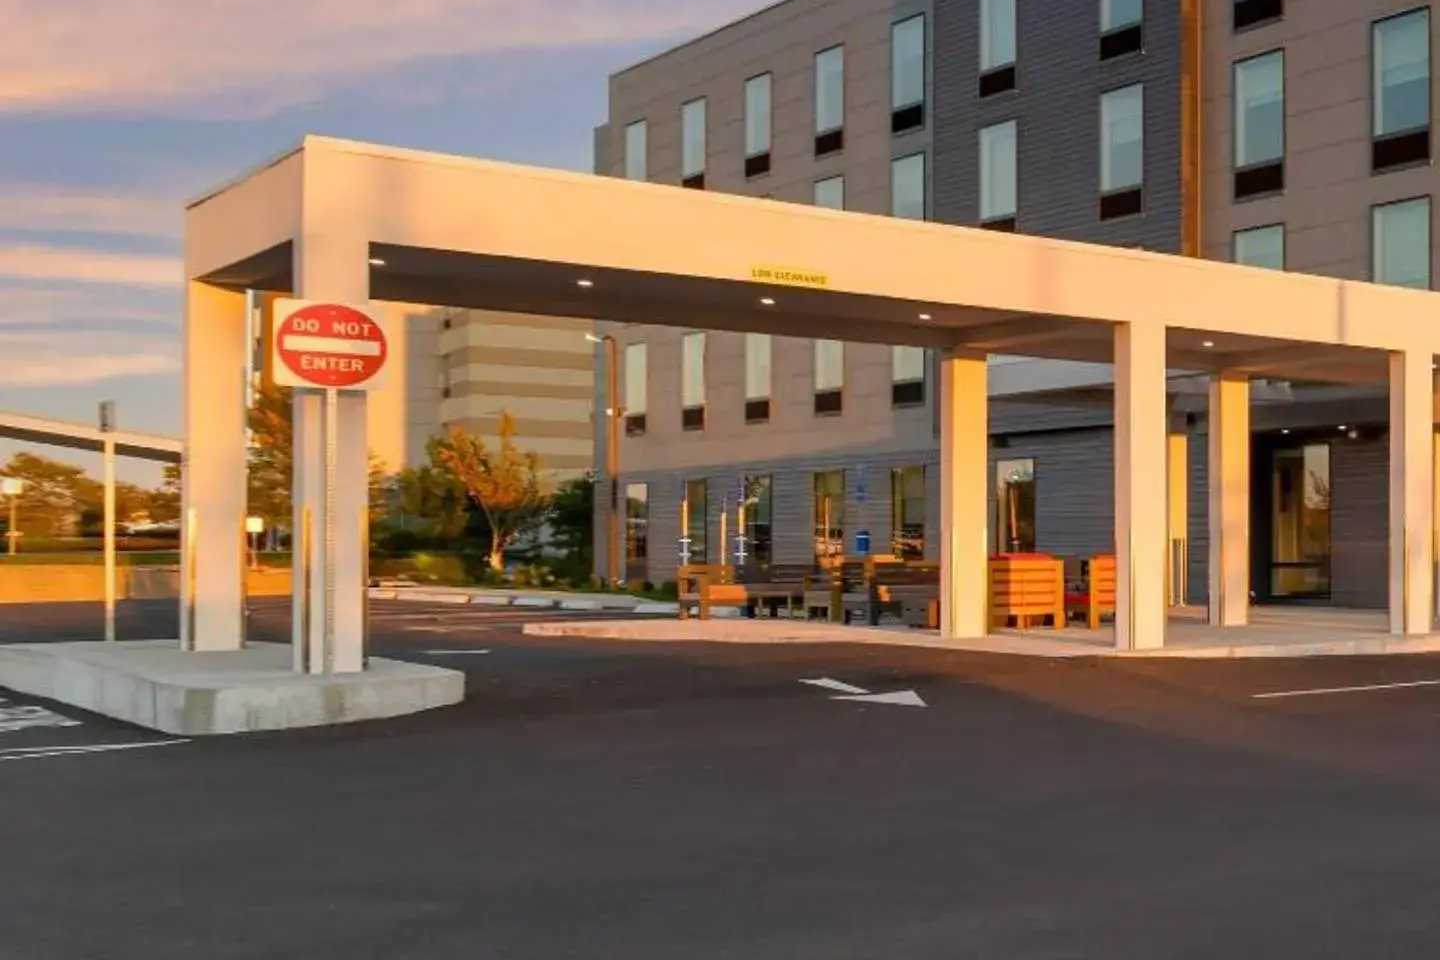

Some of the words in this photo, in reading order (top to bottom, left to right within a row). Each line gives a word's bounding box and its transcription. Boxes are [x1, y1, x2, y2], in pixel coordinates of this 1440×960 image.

[293, 319, 320, 333] DO
[332, 322, 373, 337] NOT
[301, 355, 364, 372] ENTER
